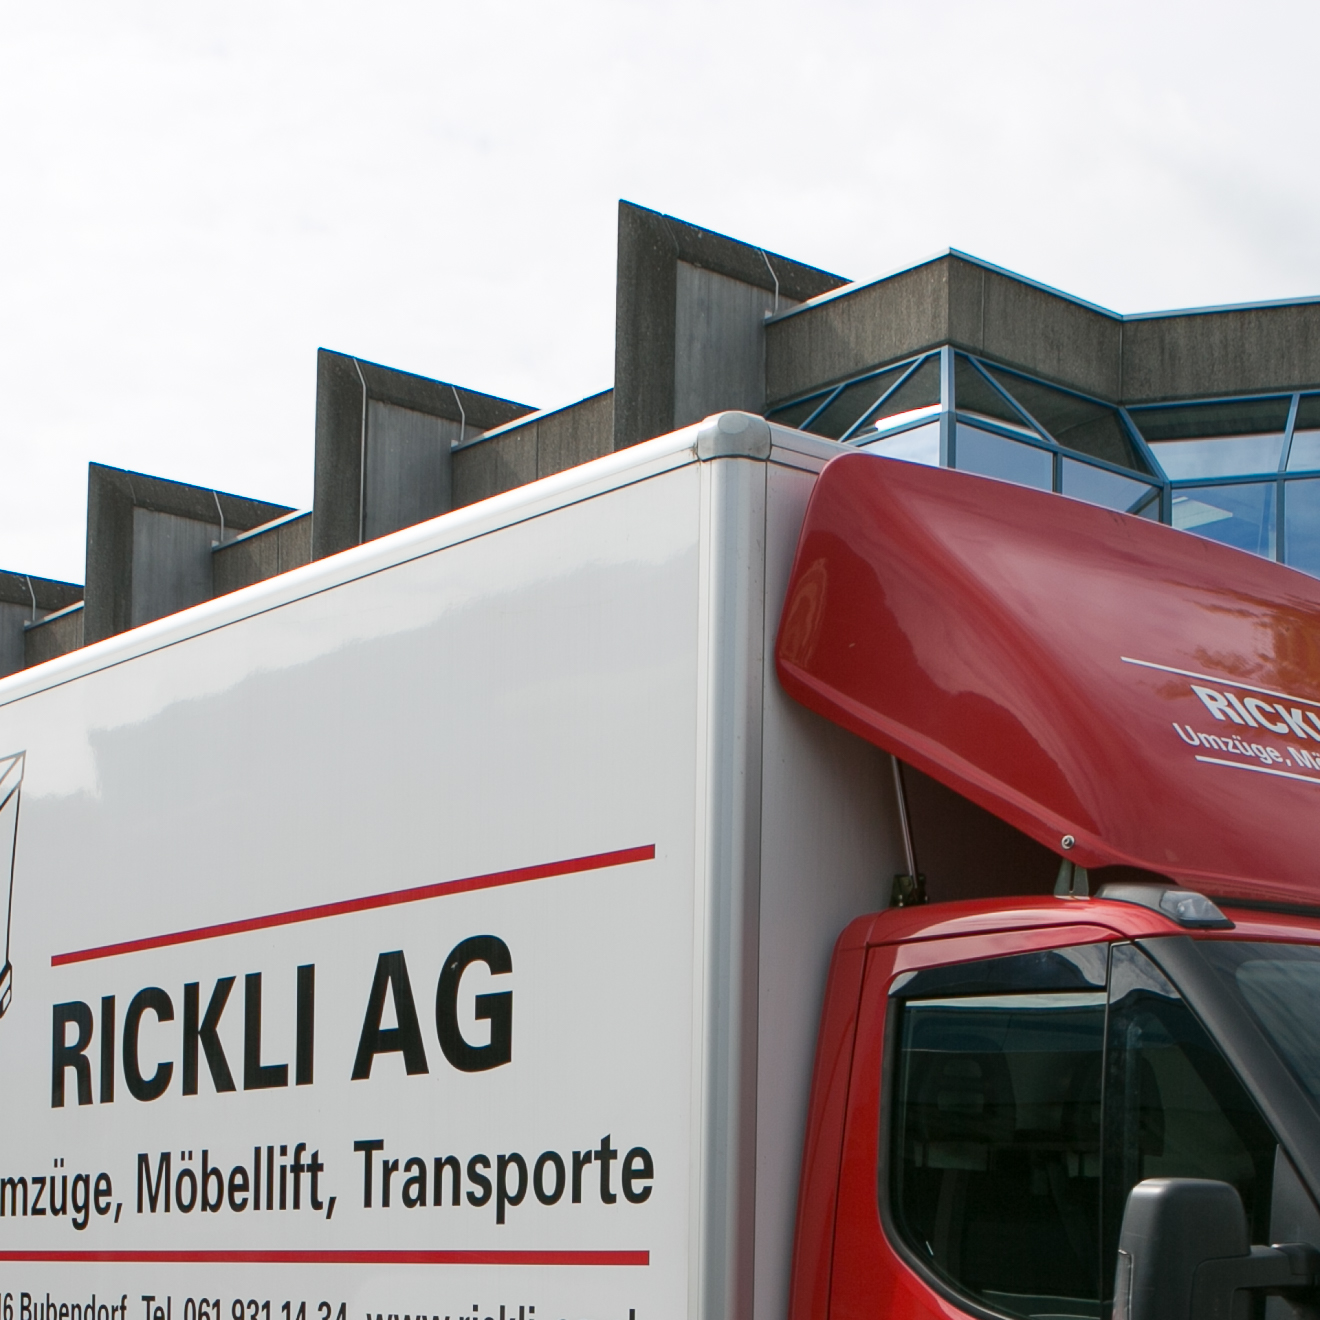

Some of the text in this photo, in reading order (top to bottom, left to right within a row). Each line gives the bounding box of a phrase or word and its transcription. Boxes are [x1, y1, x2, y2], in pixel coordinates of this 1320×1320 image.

[1172, 722, 1292, 767] Umzüge,
[51, 934, 513, 1109] RICKLI AG
[136, 1142, 337, 1220] Möbellift,
[353, 1133, 655, 1225] Transporte
